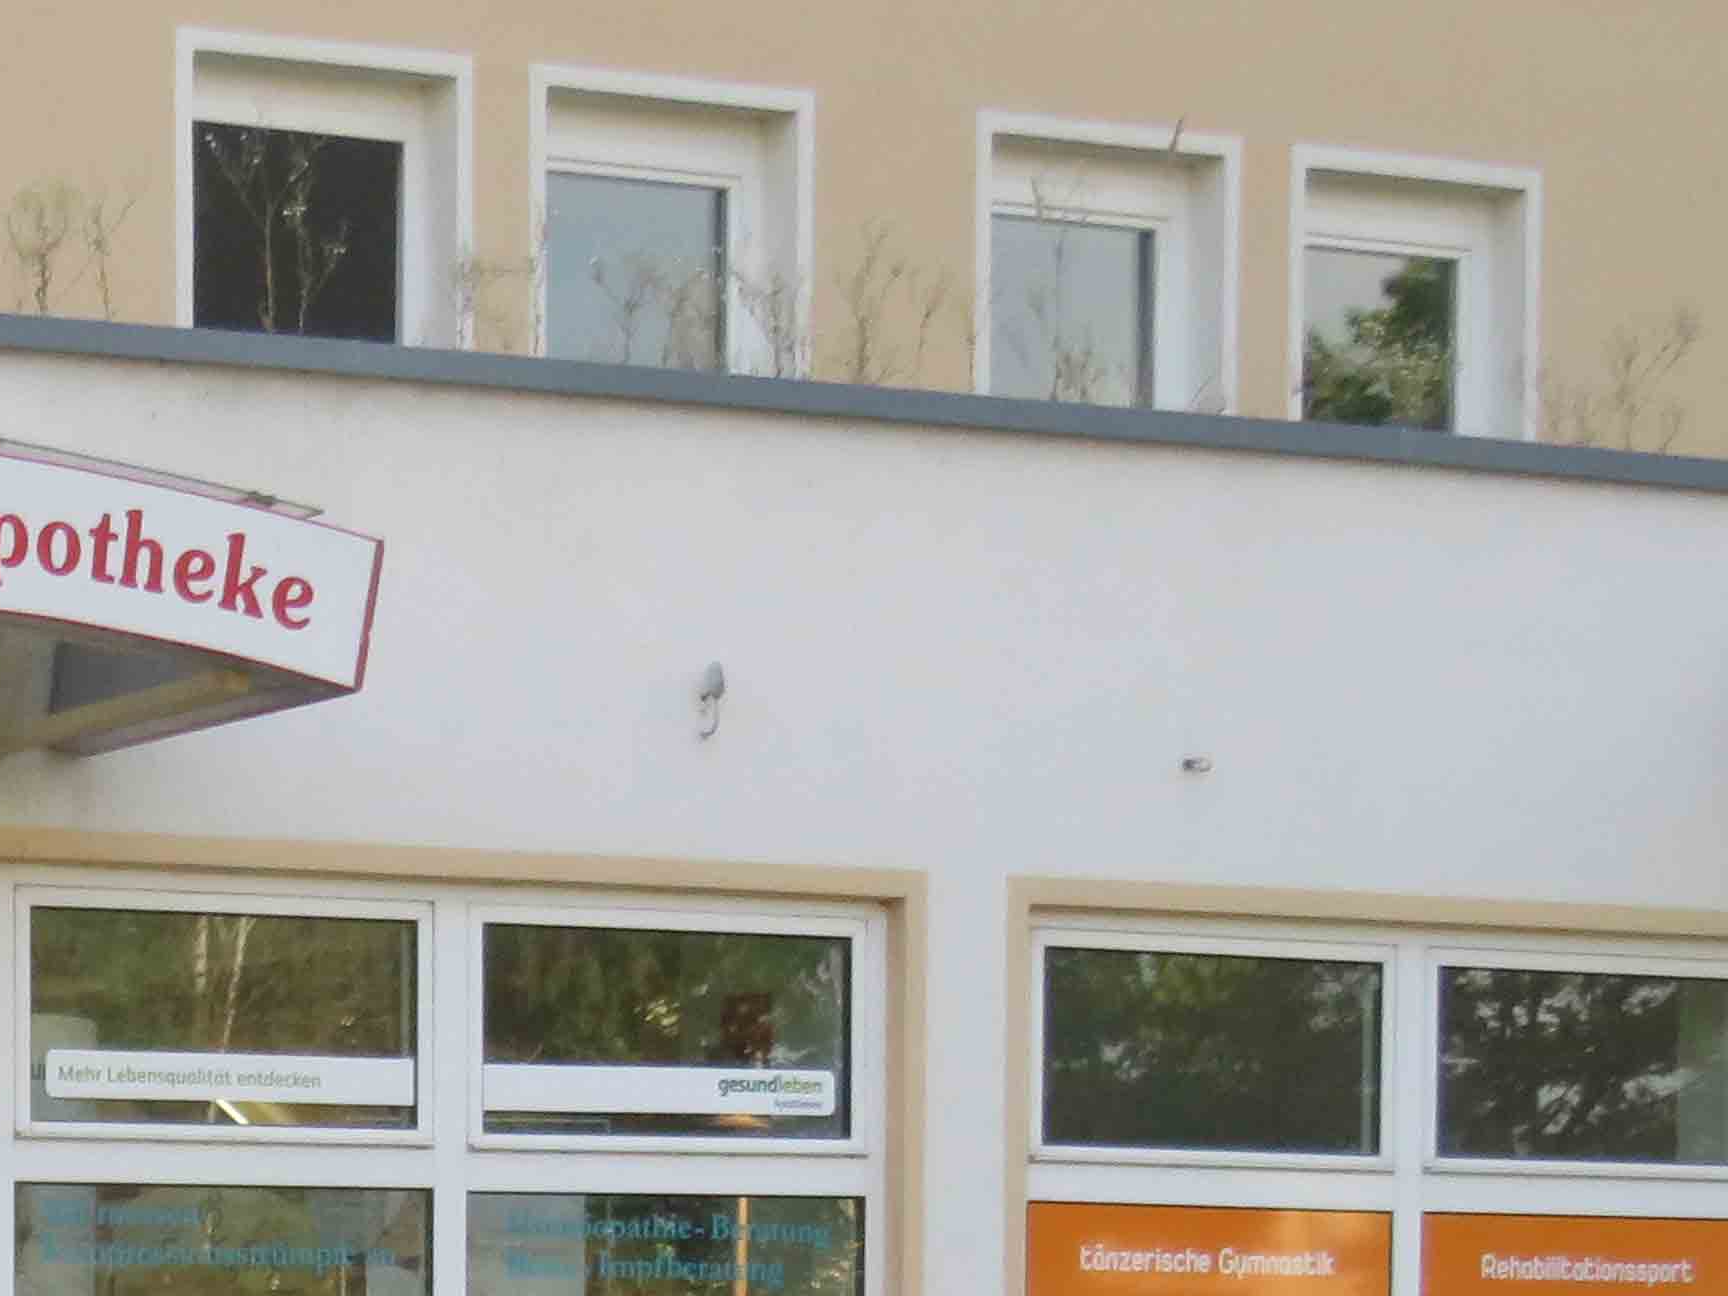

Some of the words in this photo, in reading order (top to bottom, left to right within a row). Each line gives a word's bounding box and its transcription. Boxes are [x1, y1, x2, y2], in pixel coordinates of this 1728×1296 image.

[57, 1065, 106, 1084] Mehr
[236, 1072, 321, 1090] entdecken
[718, 1074, 823, 1097] gesundleben
[1079, 1245, 1211, 1274] tänzerische
[1219, 1246, 1337, 1279] Gymnastik
[1480, 1252, 1693, 1286] Rehabilitationssport
